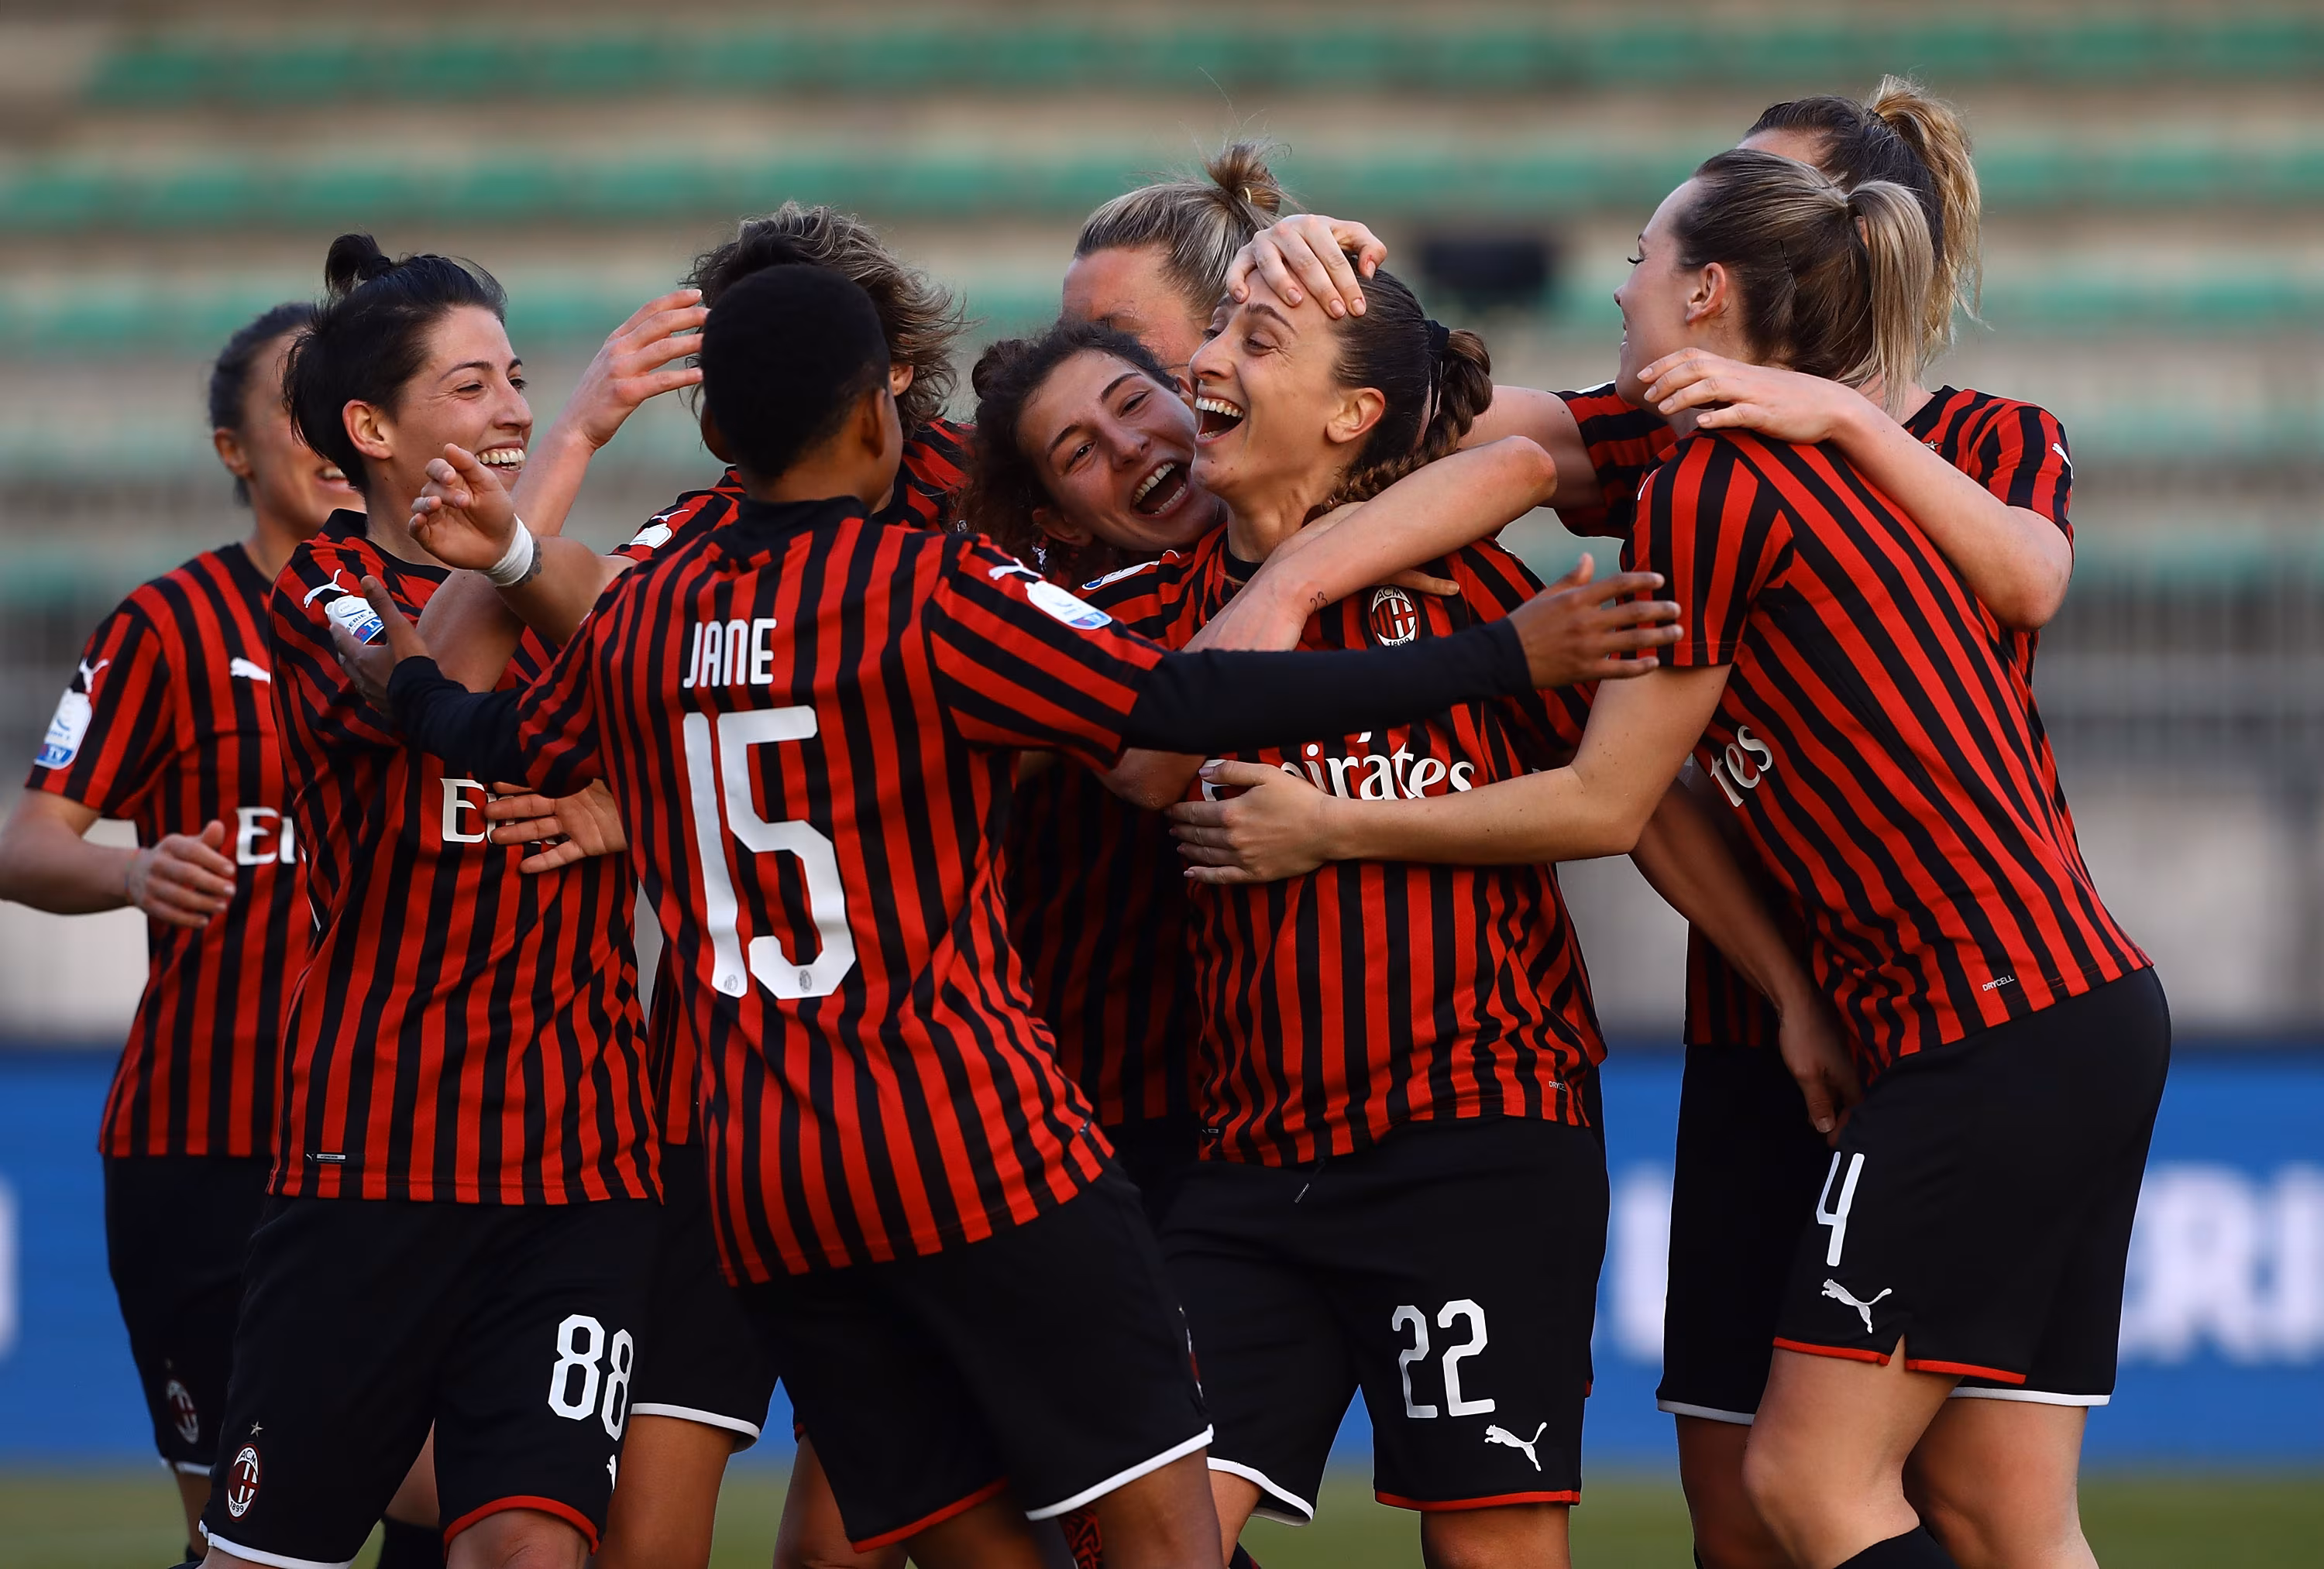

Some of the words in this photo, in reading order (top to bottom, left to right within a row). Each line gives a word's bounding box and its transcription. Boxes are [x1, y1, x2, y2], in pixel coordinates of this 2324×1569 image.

[1376, 588, 1403, 603] ACM
[683, 619, 776, 688] JANE
[1200, 741, 1475, 801] irates
[683, 706, 855, 999] 15
[1982, 975, 2015, 991] DRYCELL
[1817, 1152, 1865, 1266] 4
[548, 1313, 634, 1441] 88
[1392, 1299, 1495, 1418] 22
[238, 1449, 256, 1467] ACM
[229, 1500, 244, 1513] 1899
